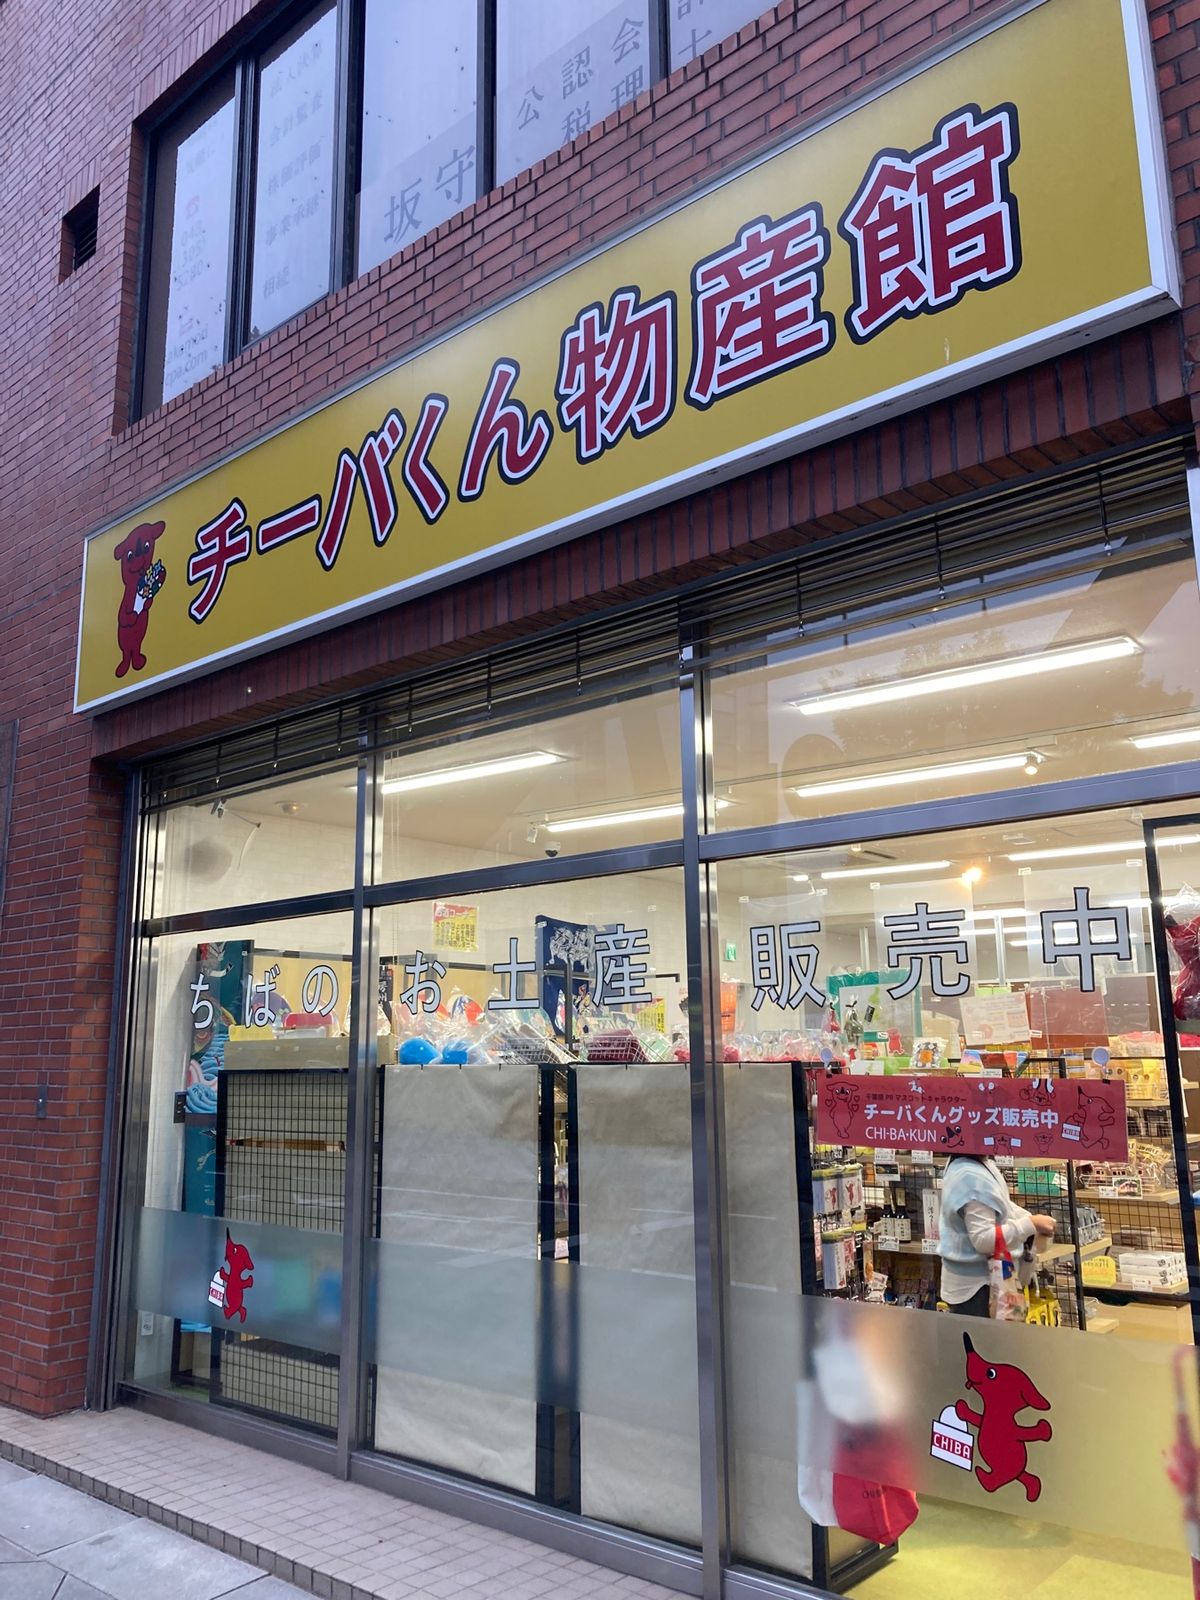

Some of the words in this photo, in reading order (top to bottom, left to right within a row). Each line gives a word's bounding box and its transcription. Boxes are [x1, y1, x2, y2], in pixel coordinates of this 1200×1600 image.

[188, 103, 1020, 623] チーバくん物産館
[863, 1103, 1059, 1129] チーバくんグッズ販売中
[933, 1433, 971, 1459] CHIBA
